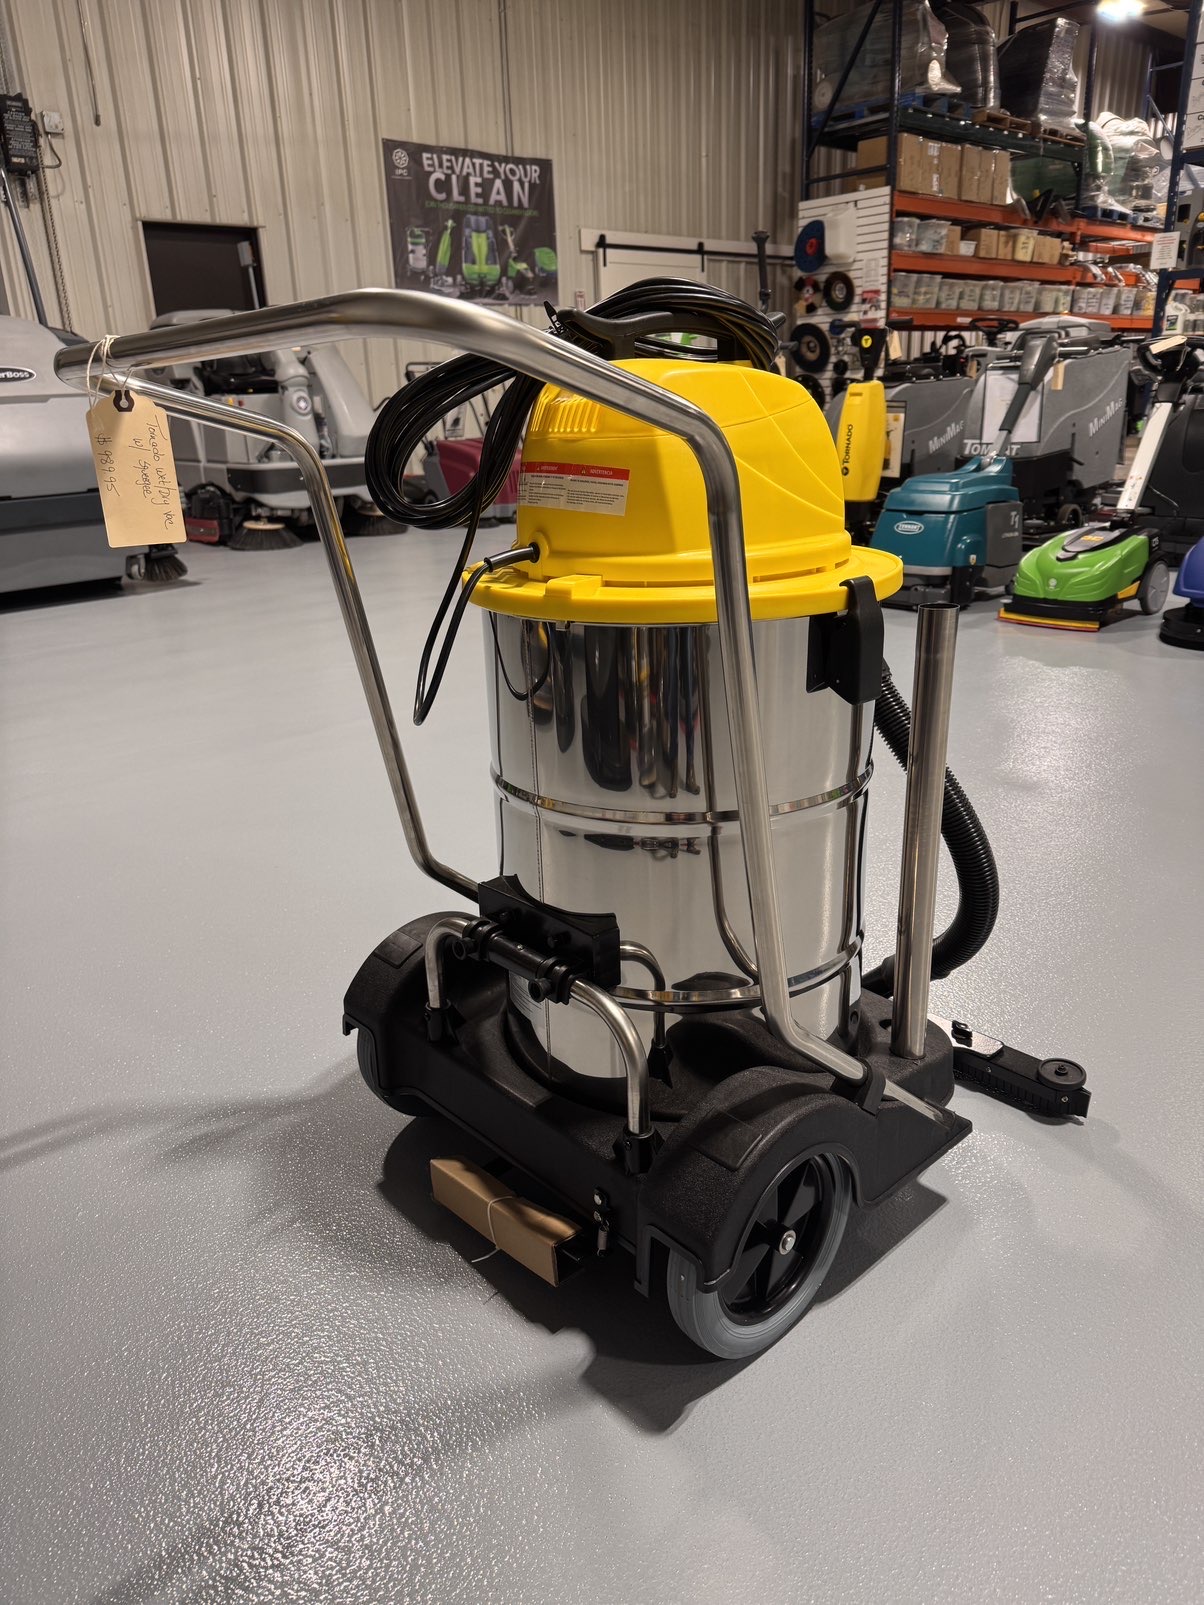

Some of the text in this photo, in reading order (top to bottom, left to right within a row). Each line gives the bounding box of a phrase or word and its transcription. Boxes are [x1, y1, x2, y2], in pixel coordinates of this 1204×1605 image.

[422, 152, 541, 184] ELEVATE YOUR
[428, 172, 530, 208] CLEAN
[146, 415, 167, 462] Tornado
[842, 424, 853, 465] TORNADO
